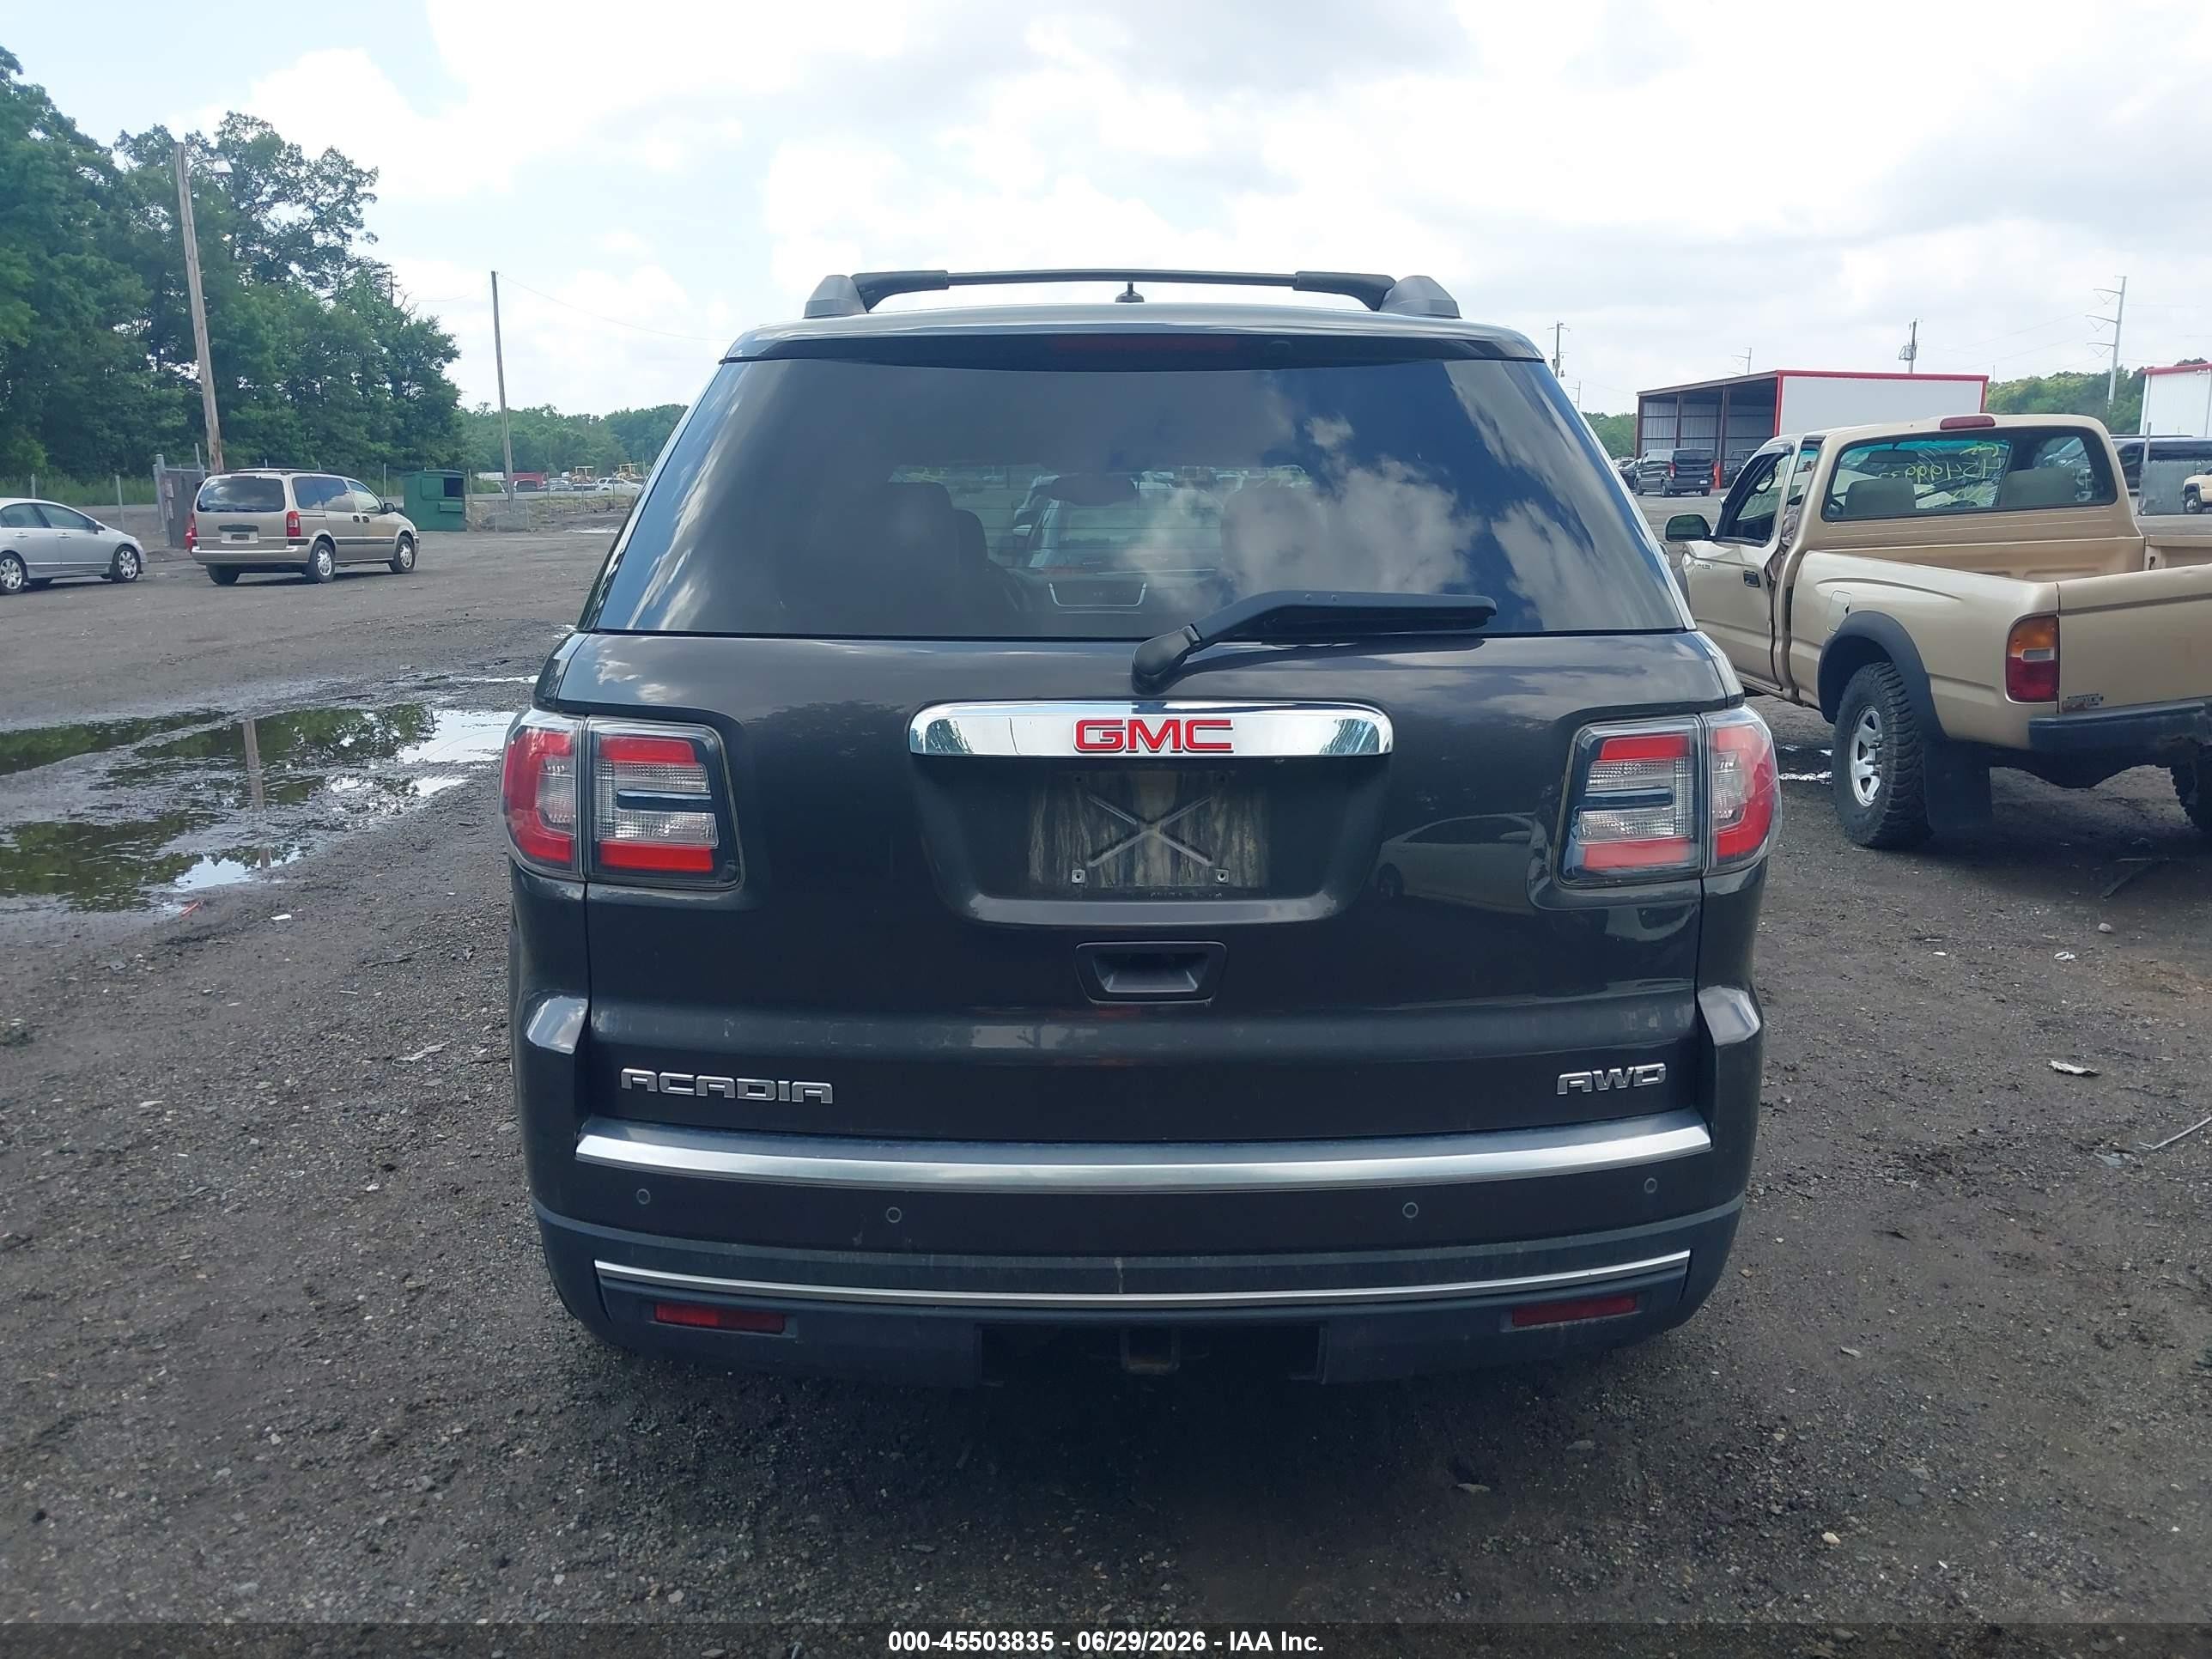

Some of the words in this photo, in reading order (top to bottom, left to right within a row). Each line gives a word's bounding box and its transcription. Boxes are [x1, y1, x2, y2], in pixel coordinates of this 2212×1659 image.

[1074, 718, 1233, 752] GMC
[621, 1067, 834, 1104] ACADIA
[1557, 1062, 1667, 1095] AWD
